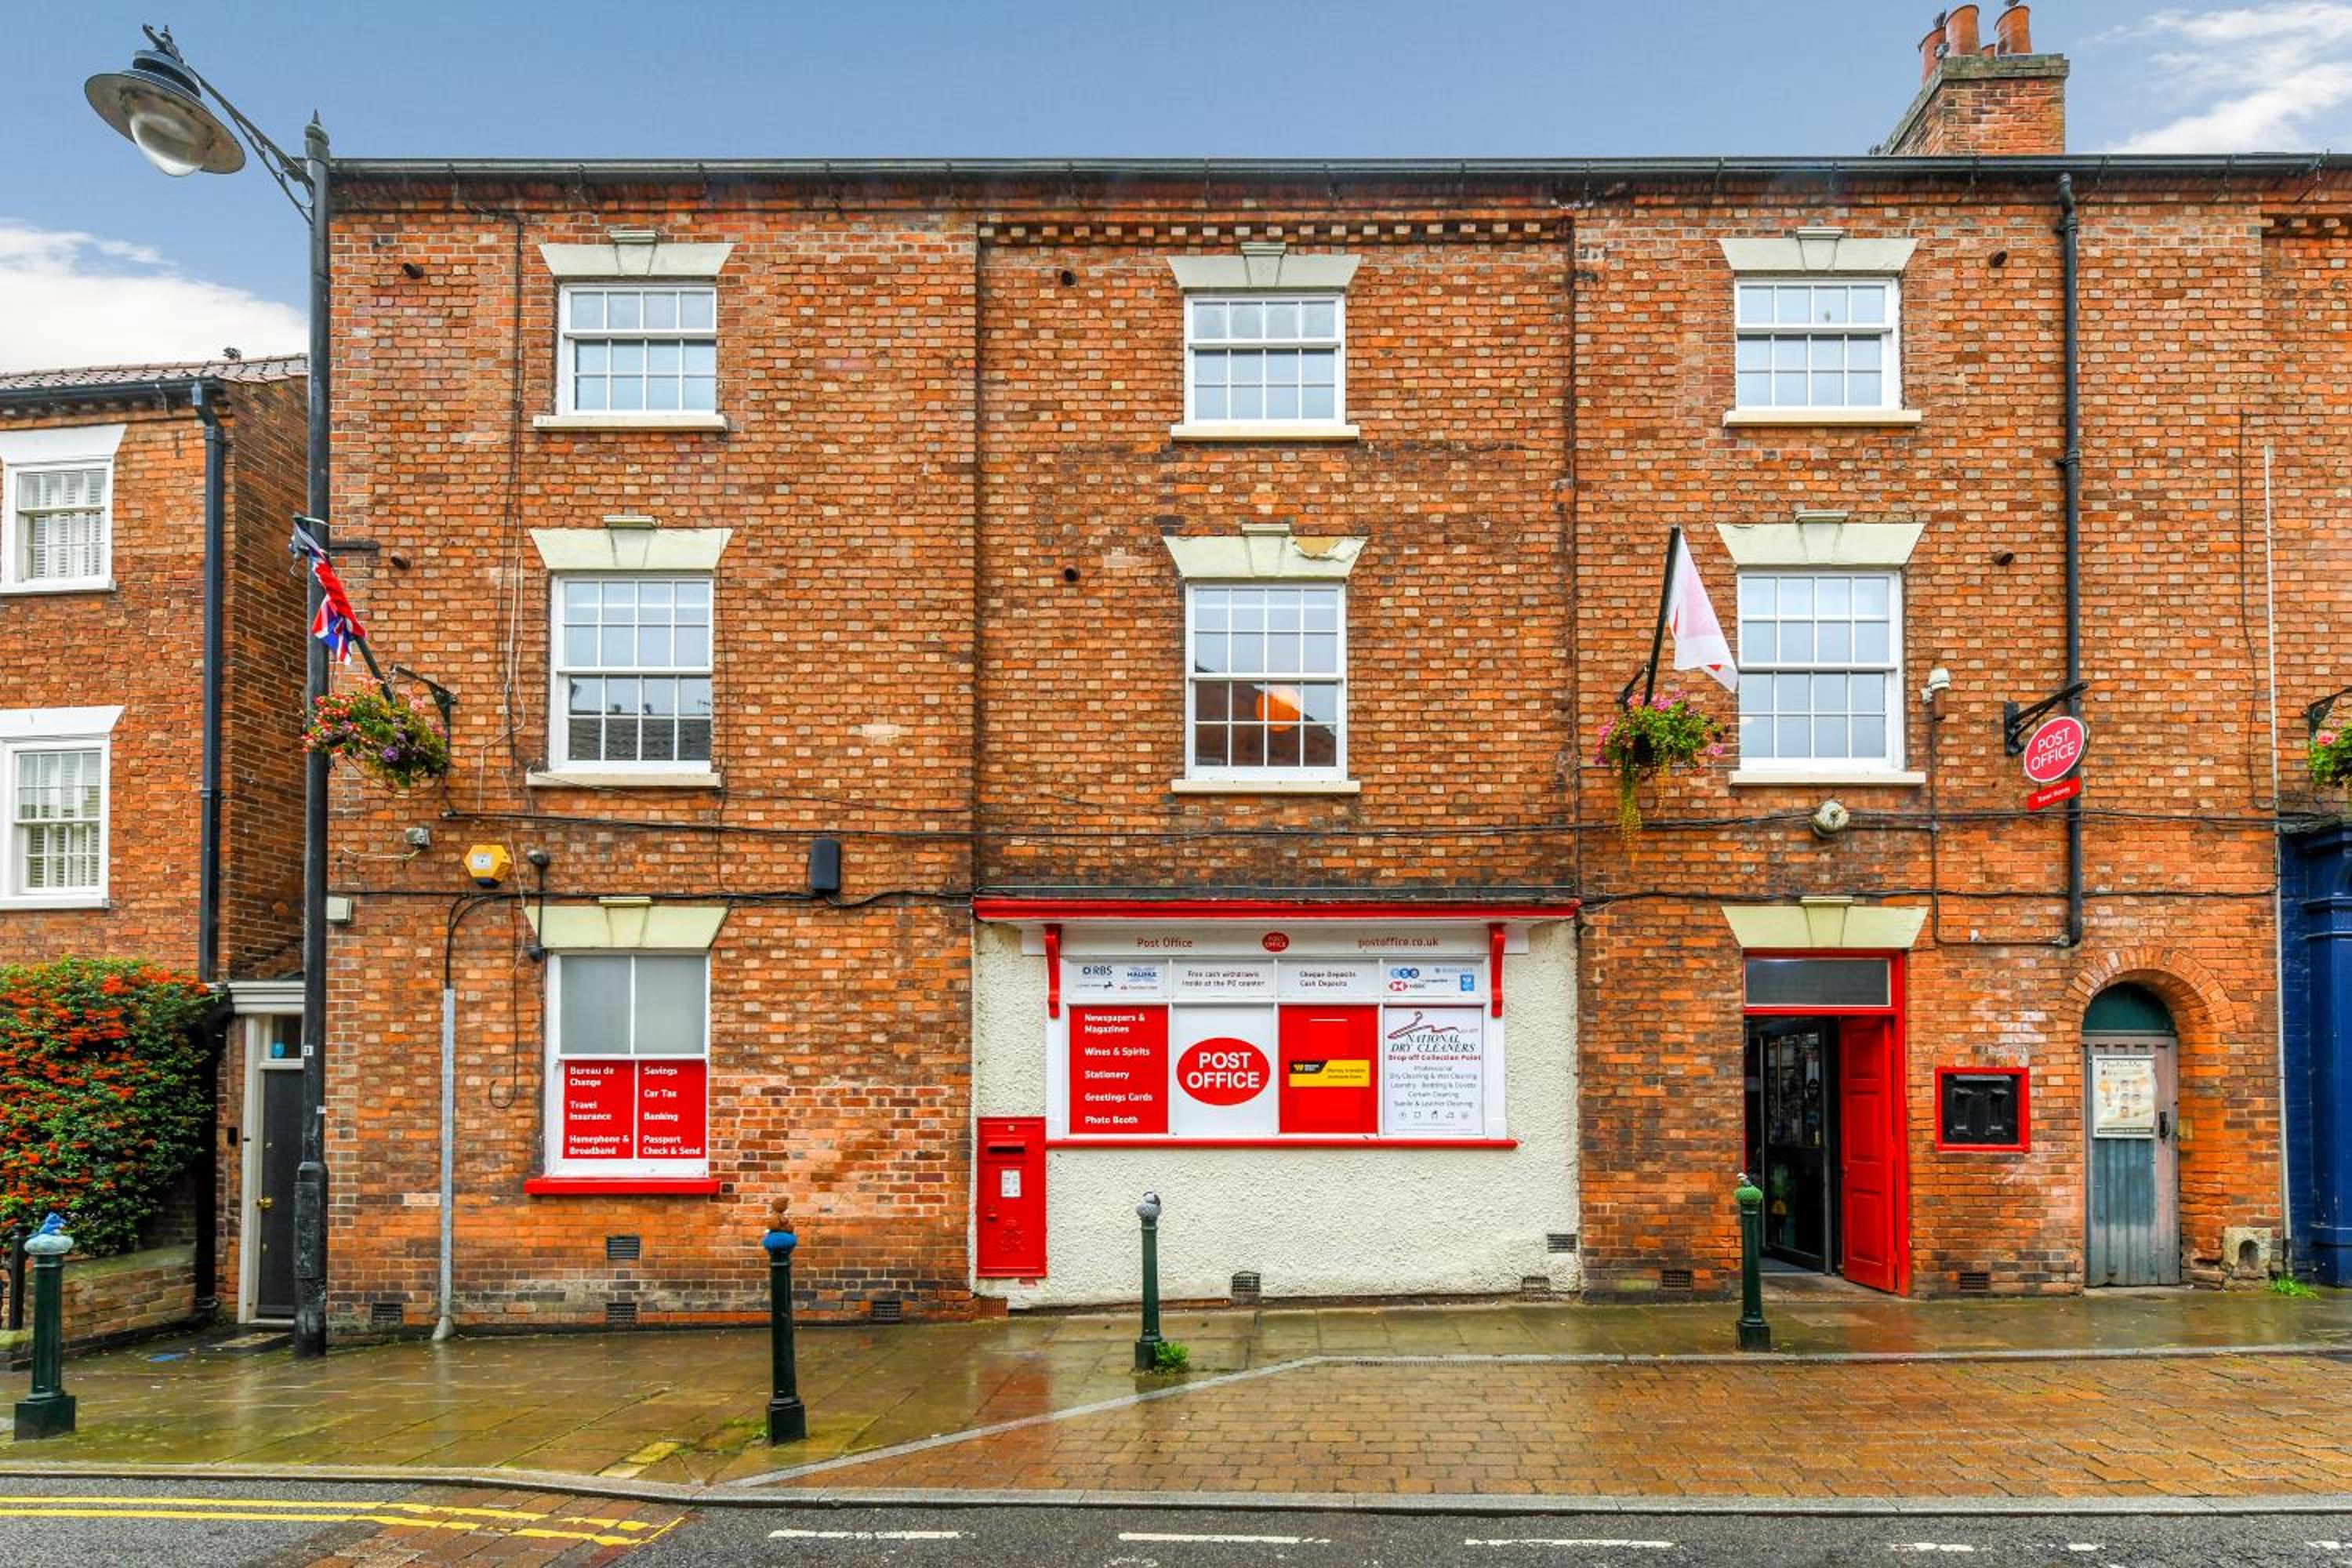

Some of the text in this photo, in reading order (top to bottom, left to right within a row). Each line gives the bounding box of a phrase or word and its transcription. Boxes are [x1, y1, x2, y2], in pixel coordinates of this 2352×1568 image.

[2038, 728, 2071, 753] POST
[2031, 741, 2075, 771] OFFICE
[1138, 938, 1192, 947] Post Office
[1358, 938, 1439, 948] postoffice.co.uk
[1093, 965, 1112, 975] RBS
[1085, 1014, 1136, 1022] Newspapers
[1085, 1025, 1129, 1034] Magazines
[1406, 1034, 1460, 1043] NATIONAL
[1085, 1047, 1150, 1057] Wines & Spirits
[1392, 1044, 1476, 1052] DRY CLEANERS
[1199, 1052, 1252, 1069] POST
[570, 1066, 614, 1075] Bureau de
[644, 1067, 678, 1076] Savings
[1085, 1071, 1129, 1079] Stationery
[570, 1079, 602, 1087] Change
[1187, 1072, 1260, 1089] OFFICE
[644, 1089, 677, 1098] Car Tax
[1085, 1093, 1153, 1103] Greetings Cards
[570, 1101, 597, 1109] Travel
[644, 1112, 678, 1122] Banking
[569, 1135, 620, 1145] Homephone
[643, 1135, 681, 1145] Passport
[569, 1146, 616, 1155] Broadband
[643, 1146, 701, 1155] Check & Send
